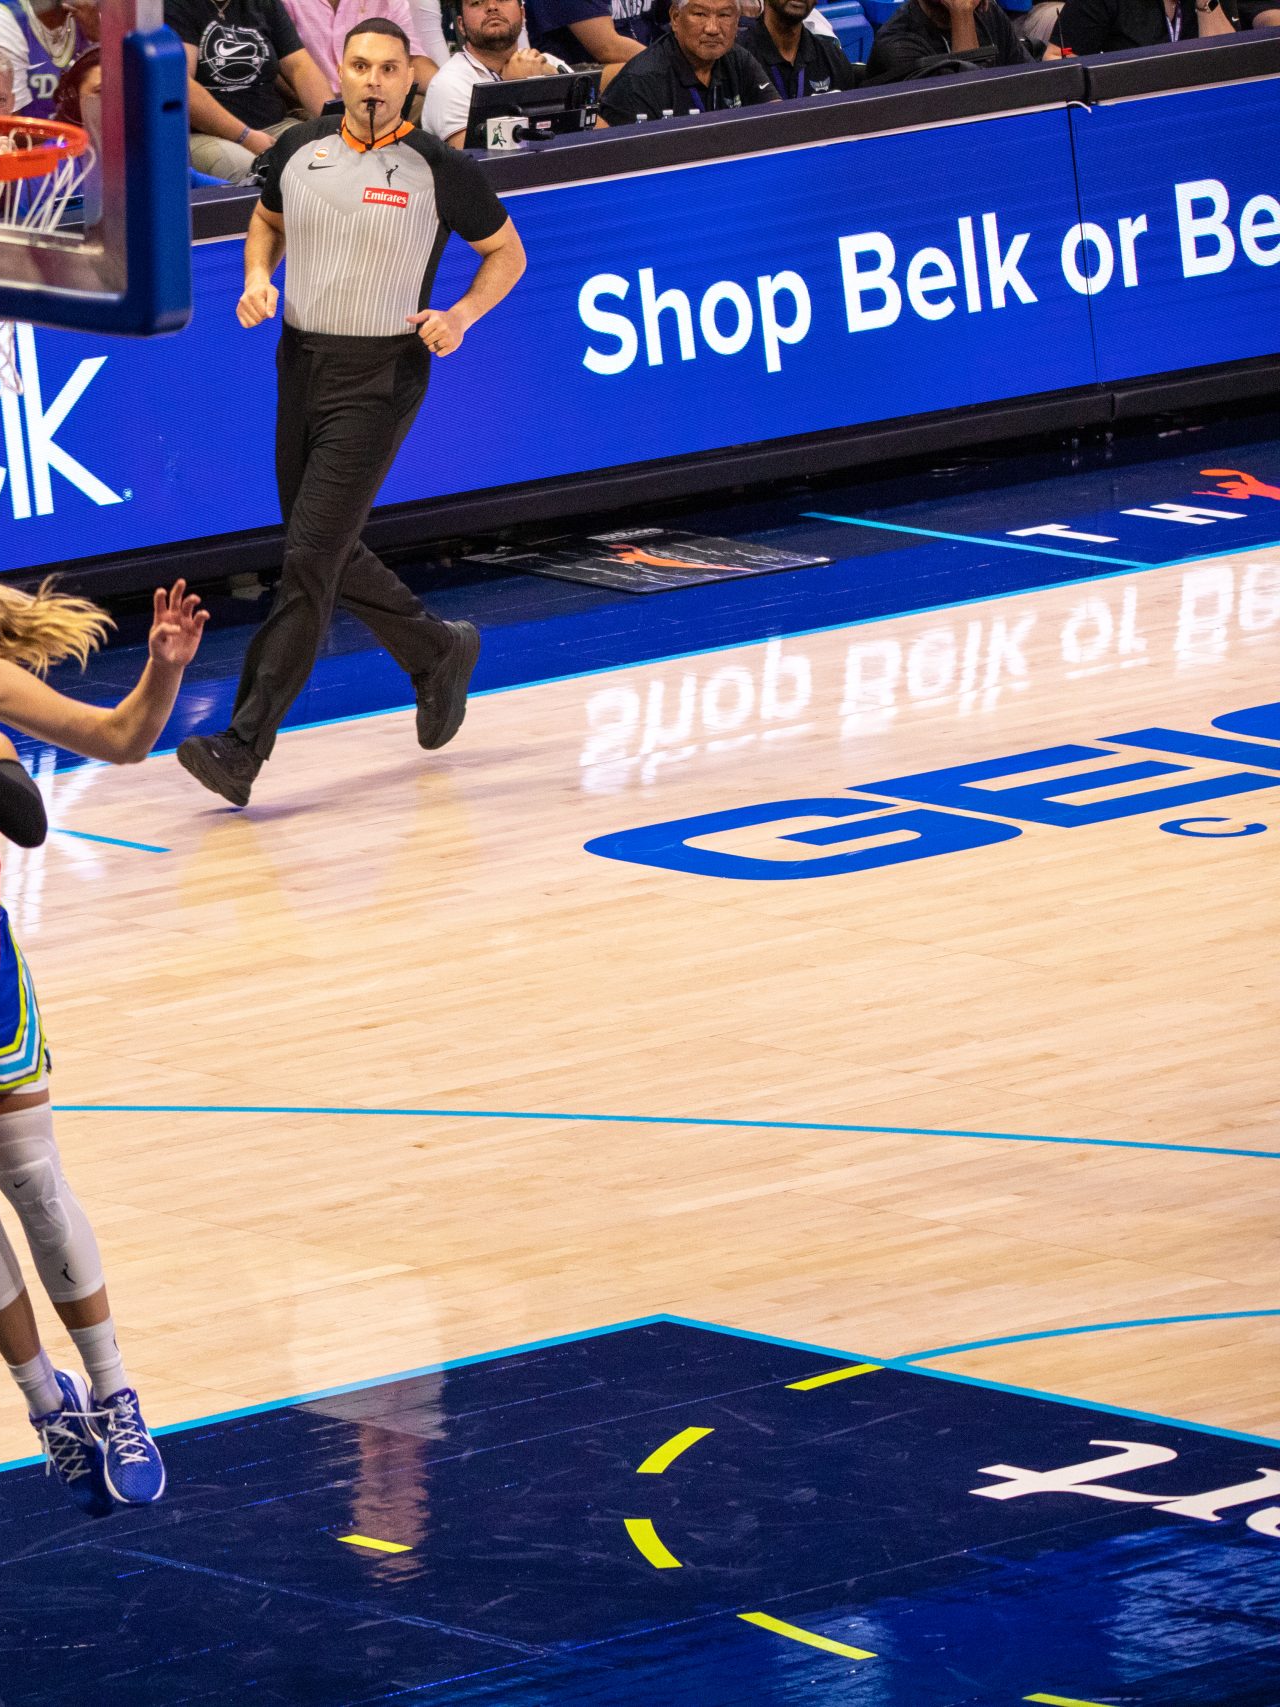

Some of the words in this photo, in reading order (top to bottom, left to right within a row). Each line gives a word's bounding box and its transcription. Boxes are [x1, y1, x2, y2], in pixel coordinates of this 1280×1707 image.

[364, 190, 408, 205] Emirates
[577, 266, 812, 376] Shop
[838, 211, 1039, 334] Belk
[1060, 213, 1148, 296] or
